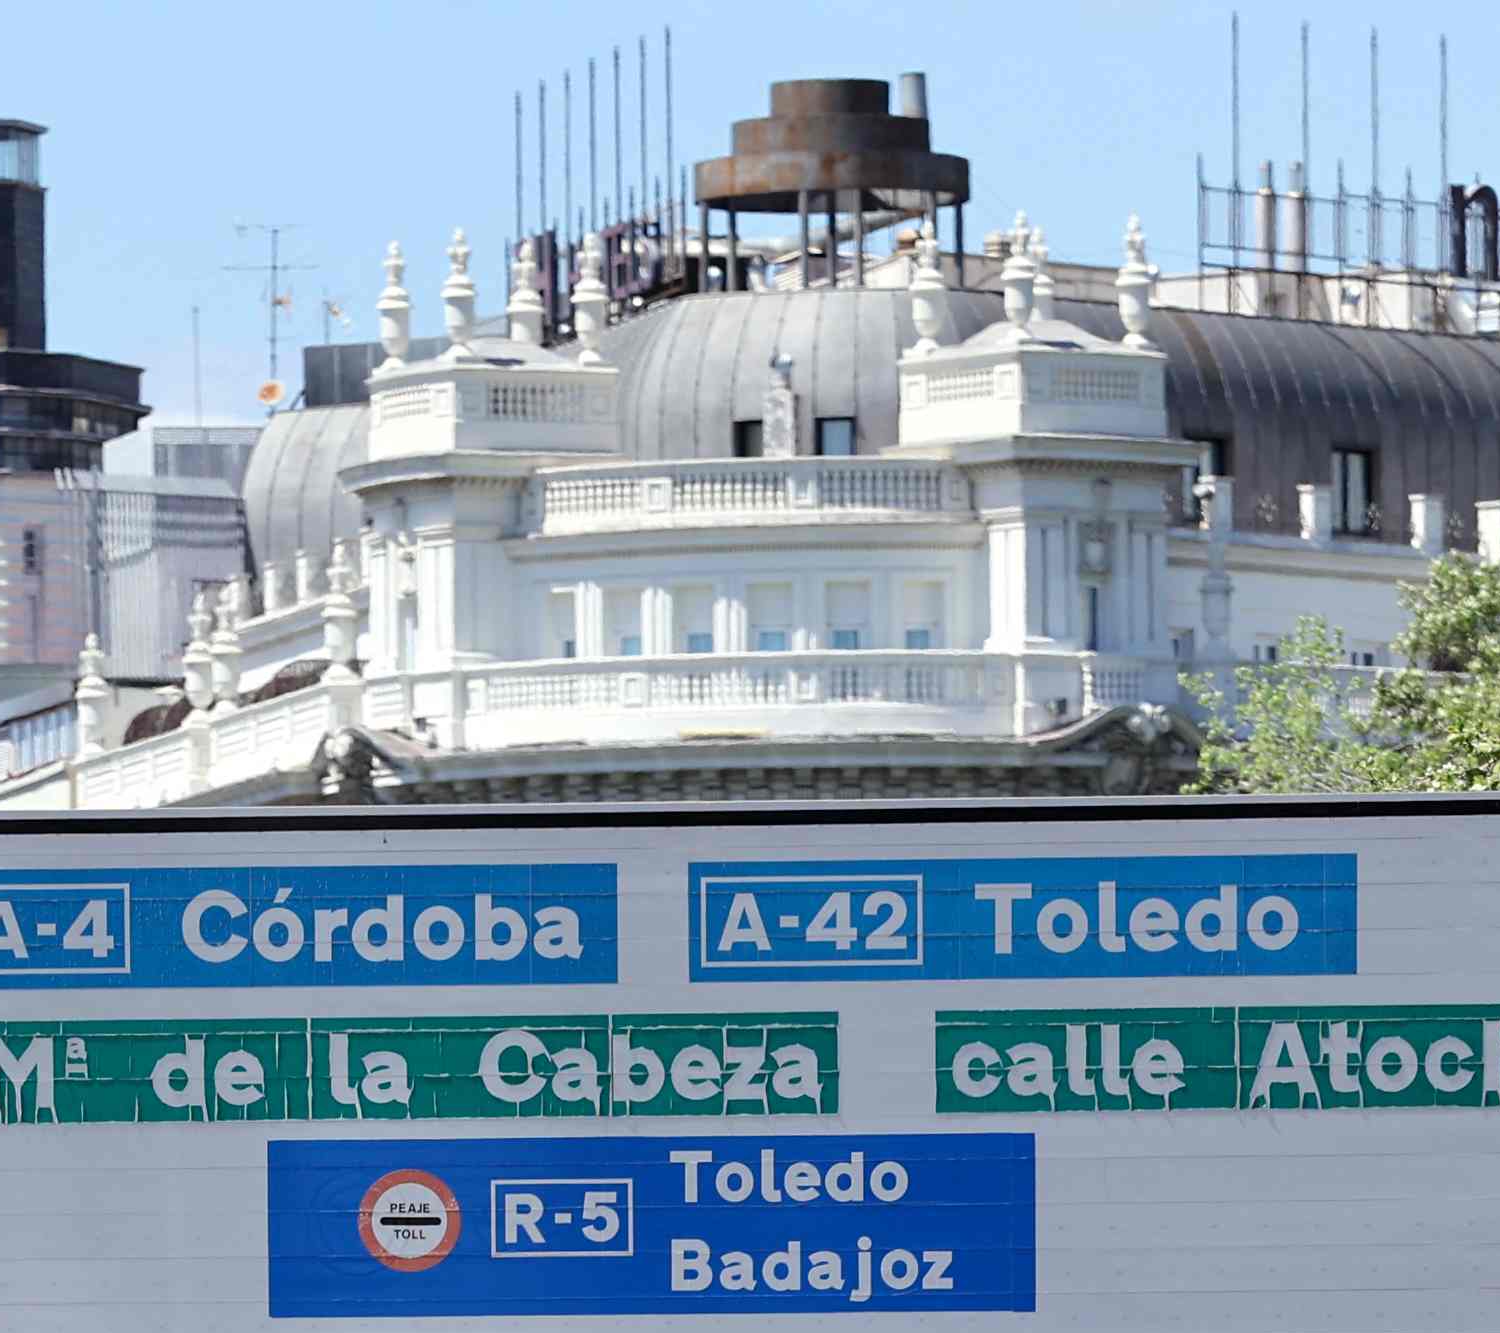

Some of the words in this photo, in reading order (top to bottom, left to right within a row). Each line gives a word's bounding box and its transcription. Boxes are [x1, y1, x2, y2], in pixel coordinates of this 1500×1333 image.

[180, 886, 584, 964] Córdoba
[717, 889, 910, 952] A-42
[975, 881, 1300, 955] Toledo
[150, 1034, 267, 1112] de
[328, 1032, 413, 1108] la
[478, 1028, 826, 1108] Cabeza
[951, 1020, 1187, 1098] calle
[390, 1203, 431, 1214] PEAJE
[670, 1149, 910, 1204] Toledo
[394, 1229, 426, 1240] TOLL
[504, 1190, 621, 1245] R-5
[670, 1236, 955, 1303] Badajoz
